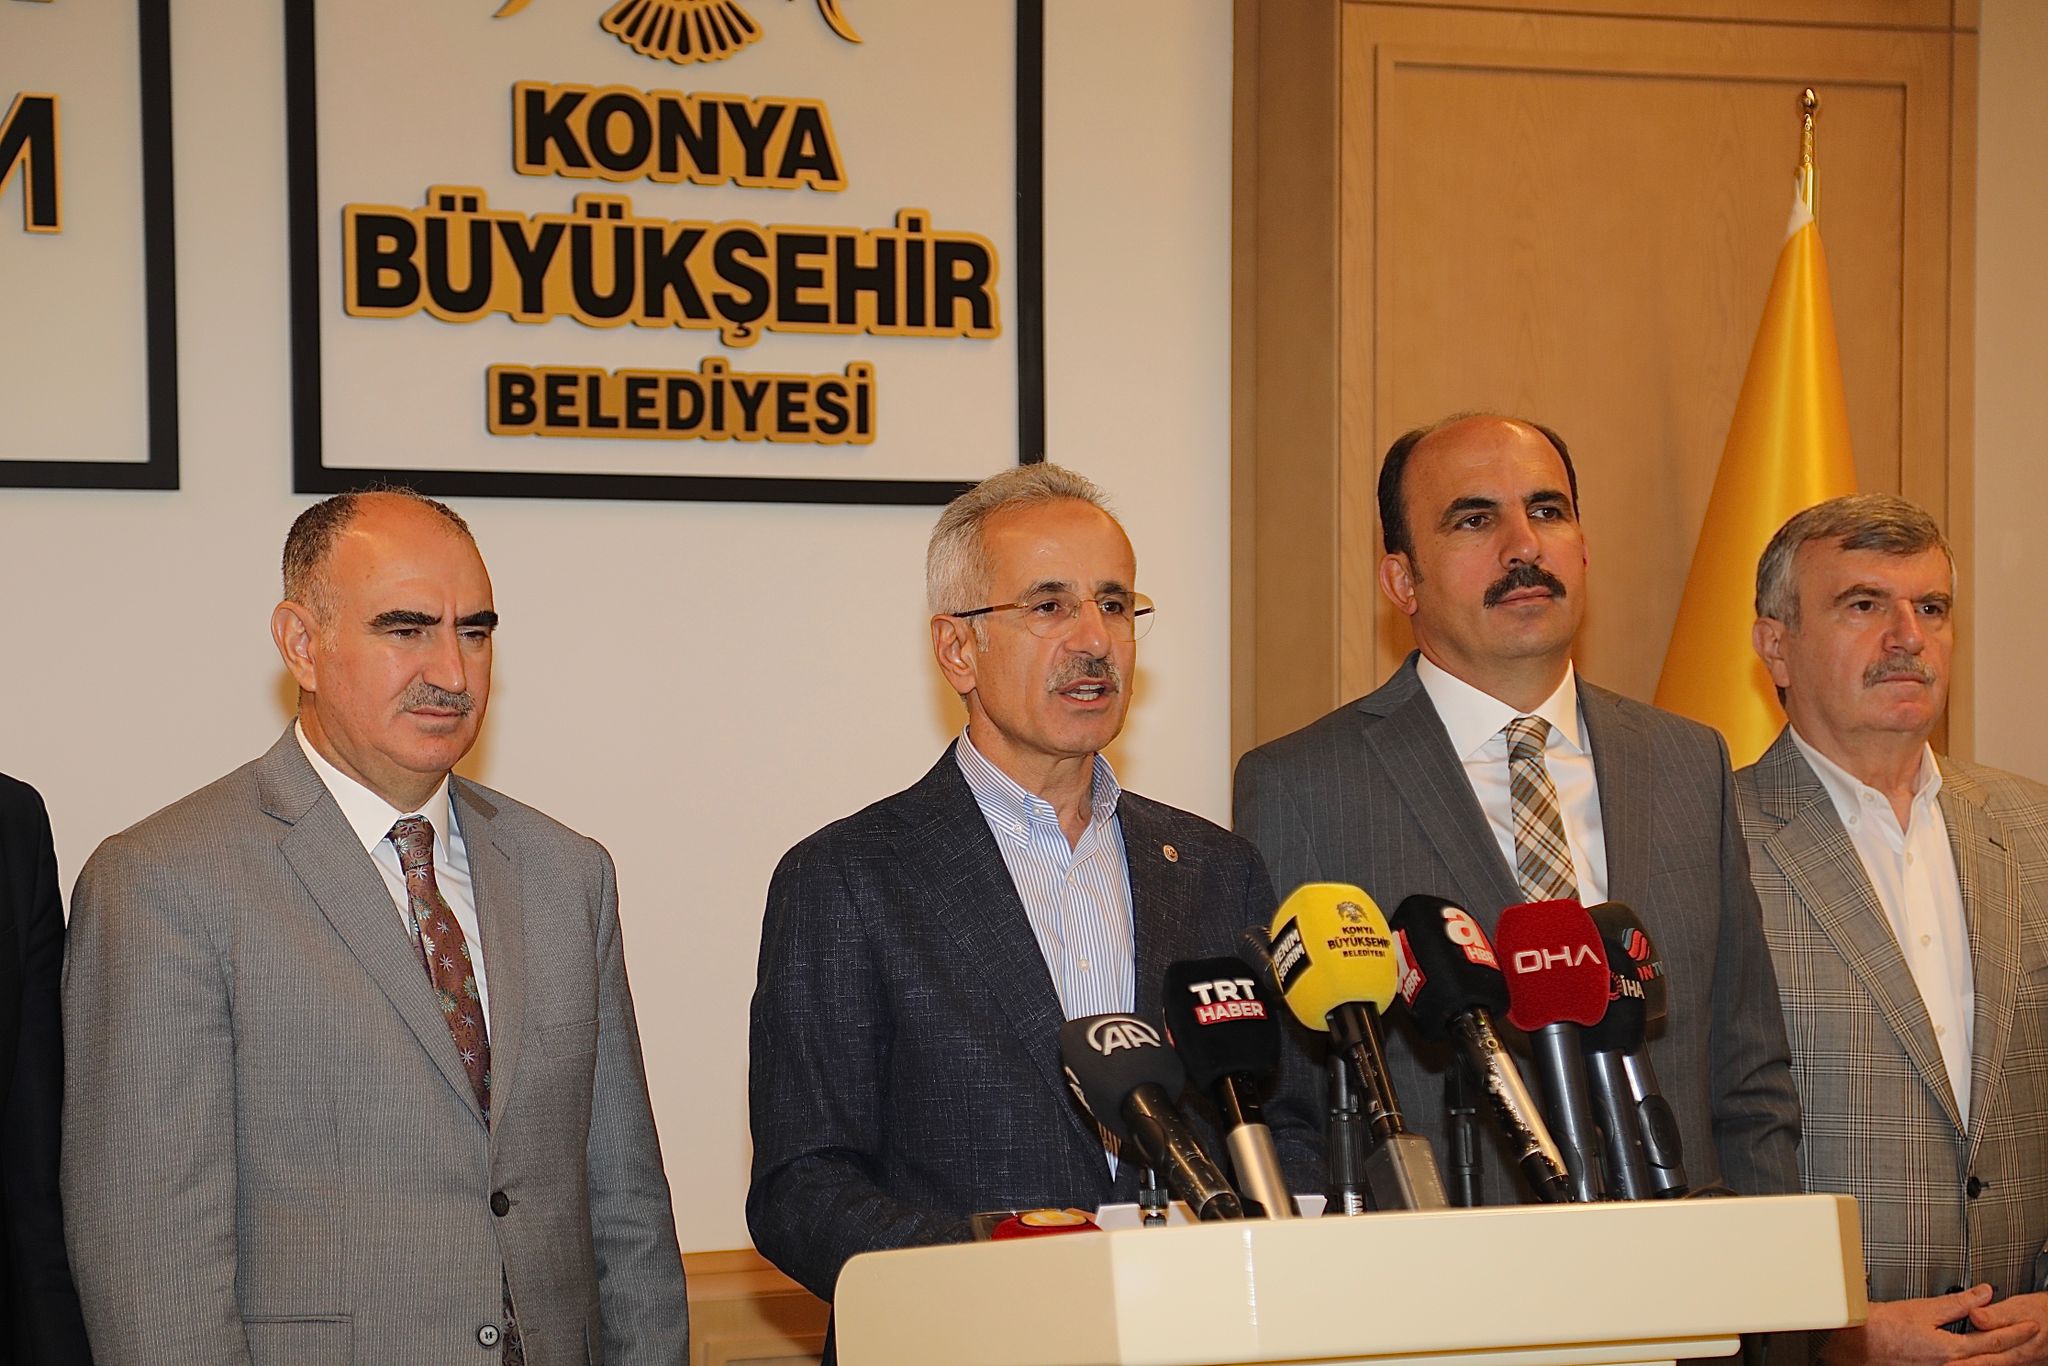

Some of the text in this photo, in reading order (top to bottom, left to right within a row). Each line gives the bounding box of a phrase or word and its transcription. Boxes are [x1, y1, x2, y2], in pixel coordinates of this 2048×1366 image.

[522, 87, 842, 184] KONYA
[351, 192, 995, 339] BÜYÜKŞEHİR
[496, 362, 872, 437] BELEDİYESİ
[1342, 927, 1375, 935] KONYA
[1466, 945, 1497, 966] HBR
[1514, 944, 1602, 974] DHA
[1188, 978, 1255, 1006] TRT
[1402, 968, 1422, 1003] HBR
[1199, 1001, 1265, 1023] HABER
